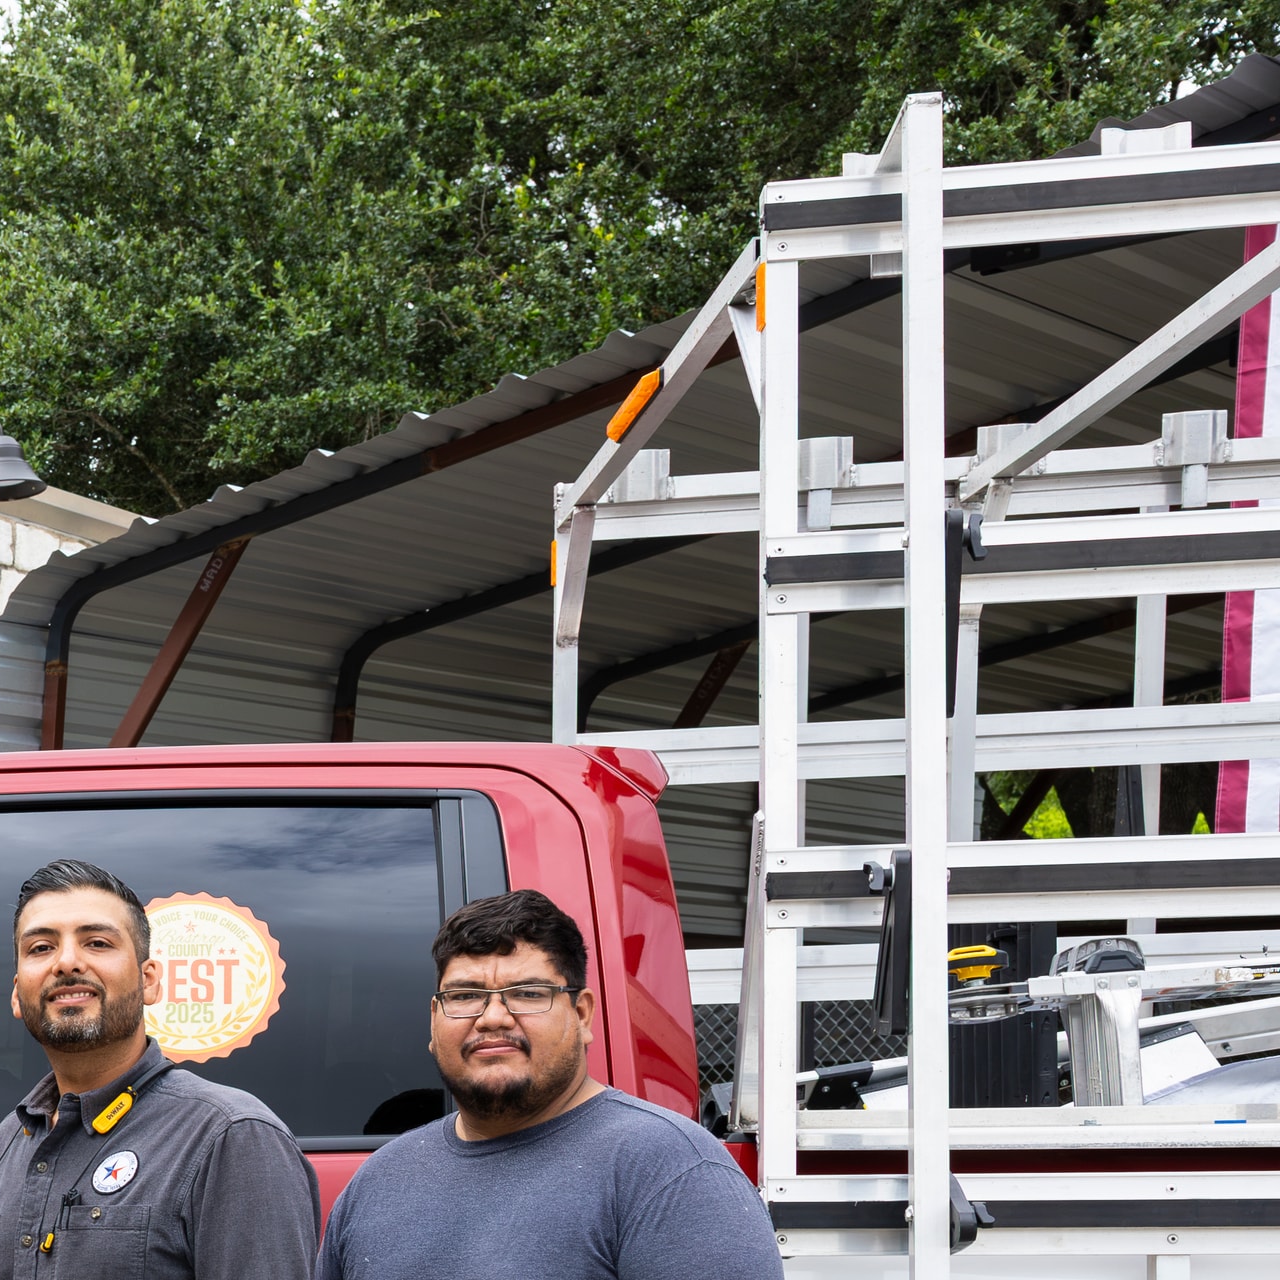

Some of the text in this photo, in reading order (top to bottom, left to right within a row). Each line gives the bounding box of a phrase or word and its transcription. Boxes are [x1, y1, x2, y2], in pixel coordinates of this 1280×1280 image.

[154, 911, 182, 926] VOICE
[193, 910, 219, 923] YOUR
[219, 917, 249, 941] CHOICE
[156, 927, 226, 945] Bastrop
[168, 943, 213, 957] COUNTY
[165, 1003, 214, 1024] 2025
